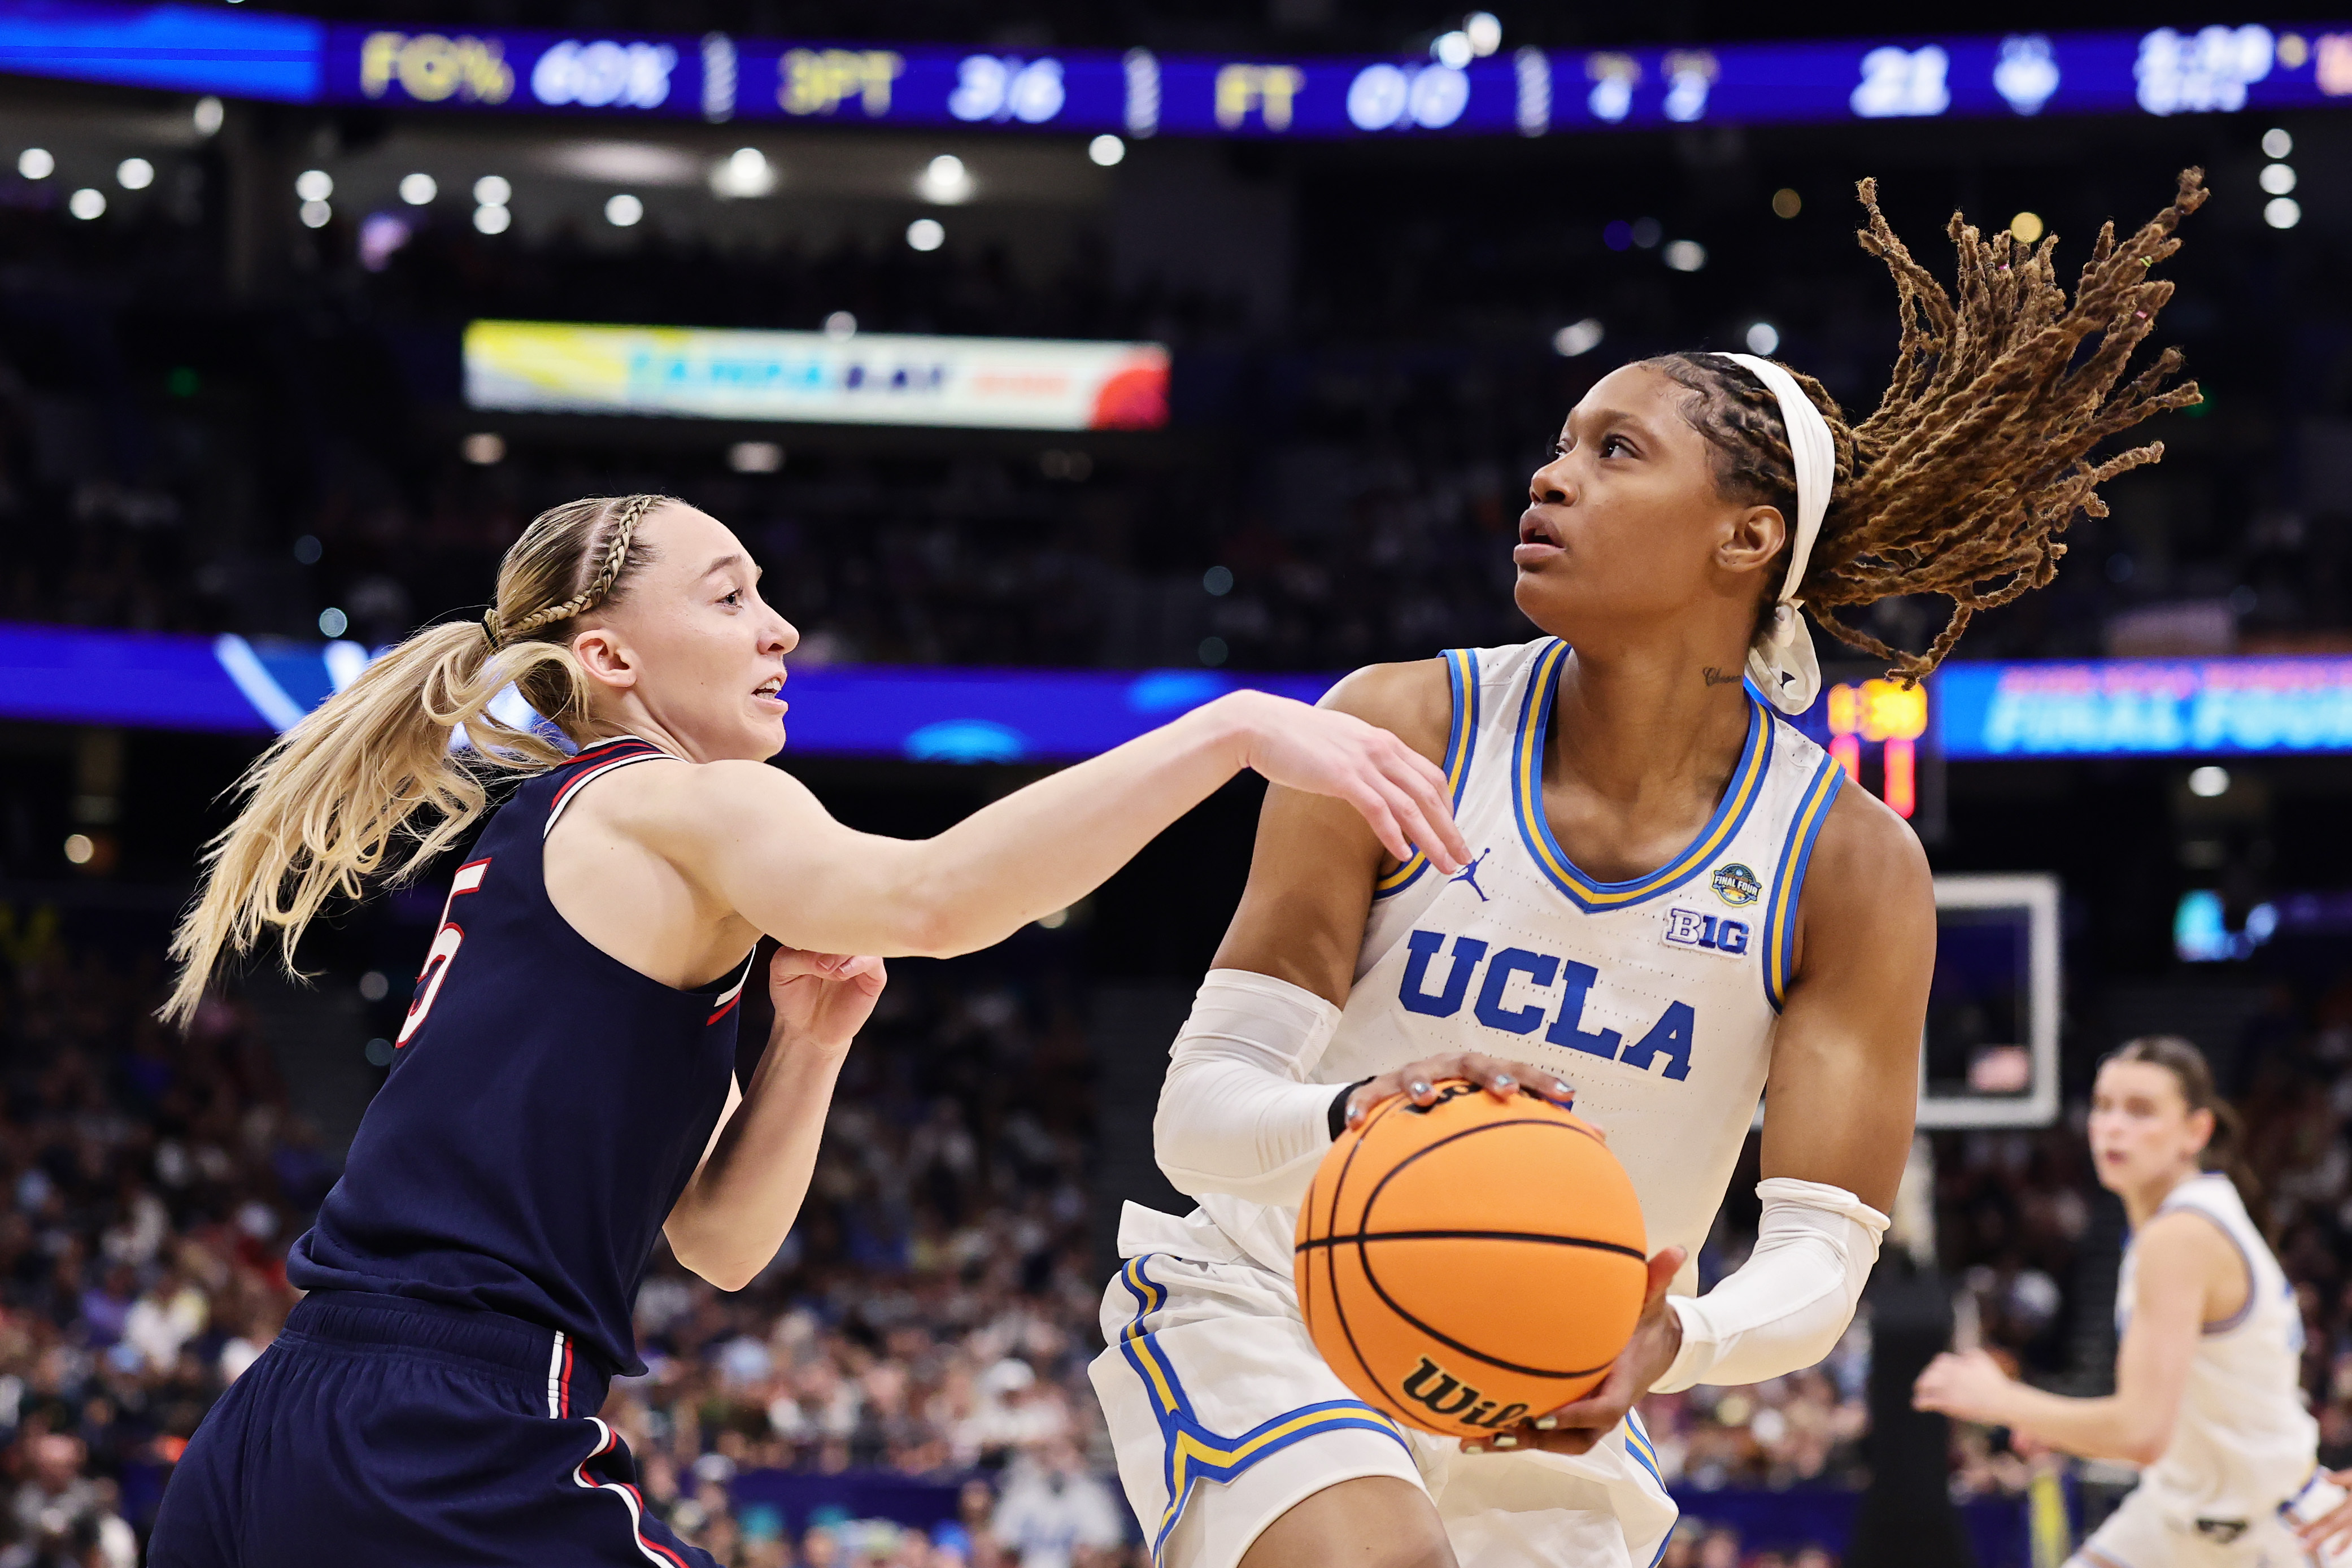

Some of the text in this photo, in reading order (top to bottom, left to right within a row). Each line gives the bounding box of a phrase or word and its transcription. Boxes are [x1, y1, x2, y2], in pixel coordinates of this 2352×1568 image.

[360, 31, 515, 103] FG%
[776, 47, 905, 117] 3PT
[1214, 63, 1306, 131] FT
[1714, 876, 1758, 896] FINAL FOUR
[396, 857, 493, 1048] 5
[1399, 930, 1695, 1082] UCLA
[1403, 1356, 1534, 1429] Wil
